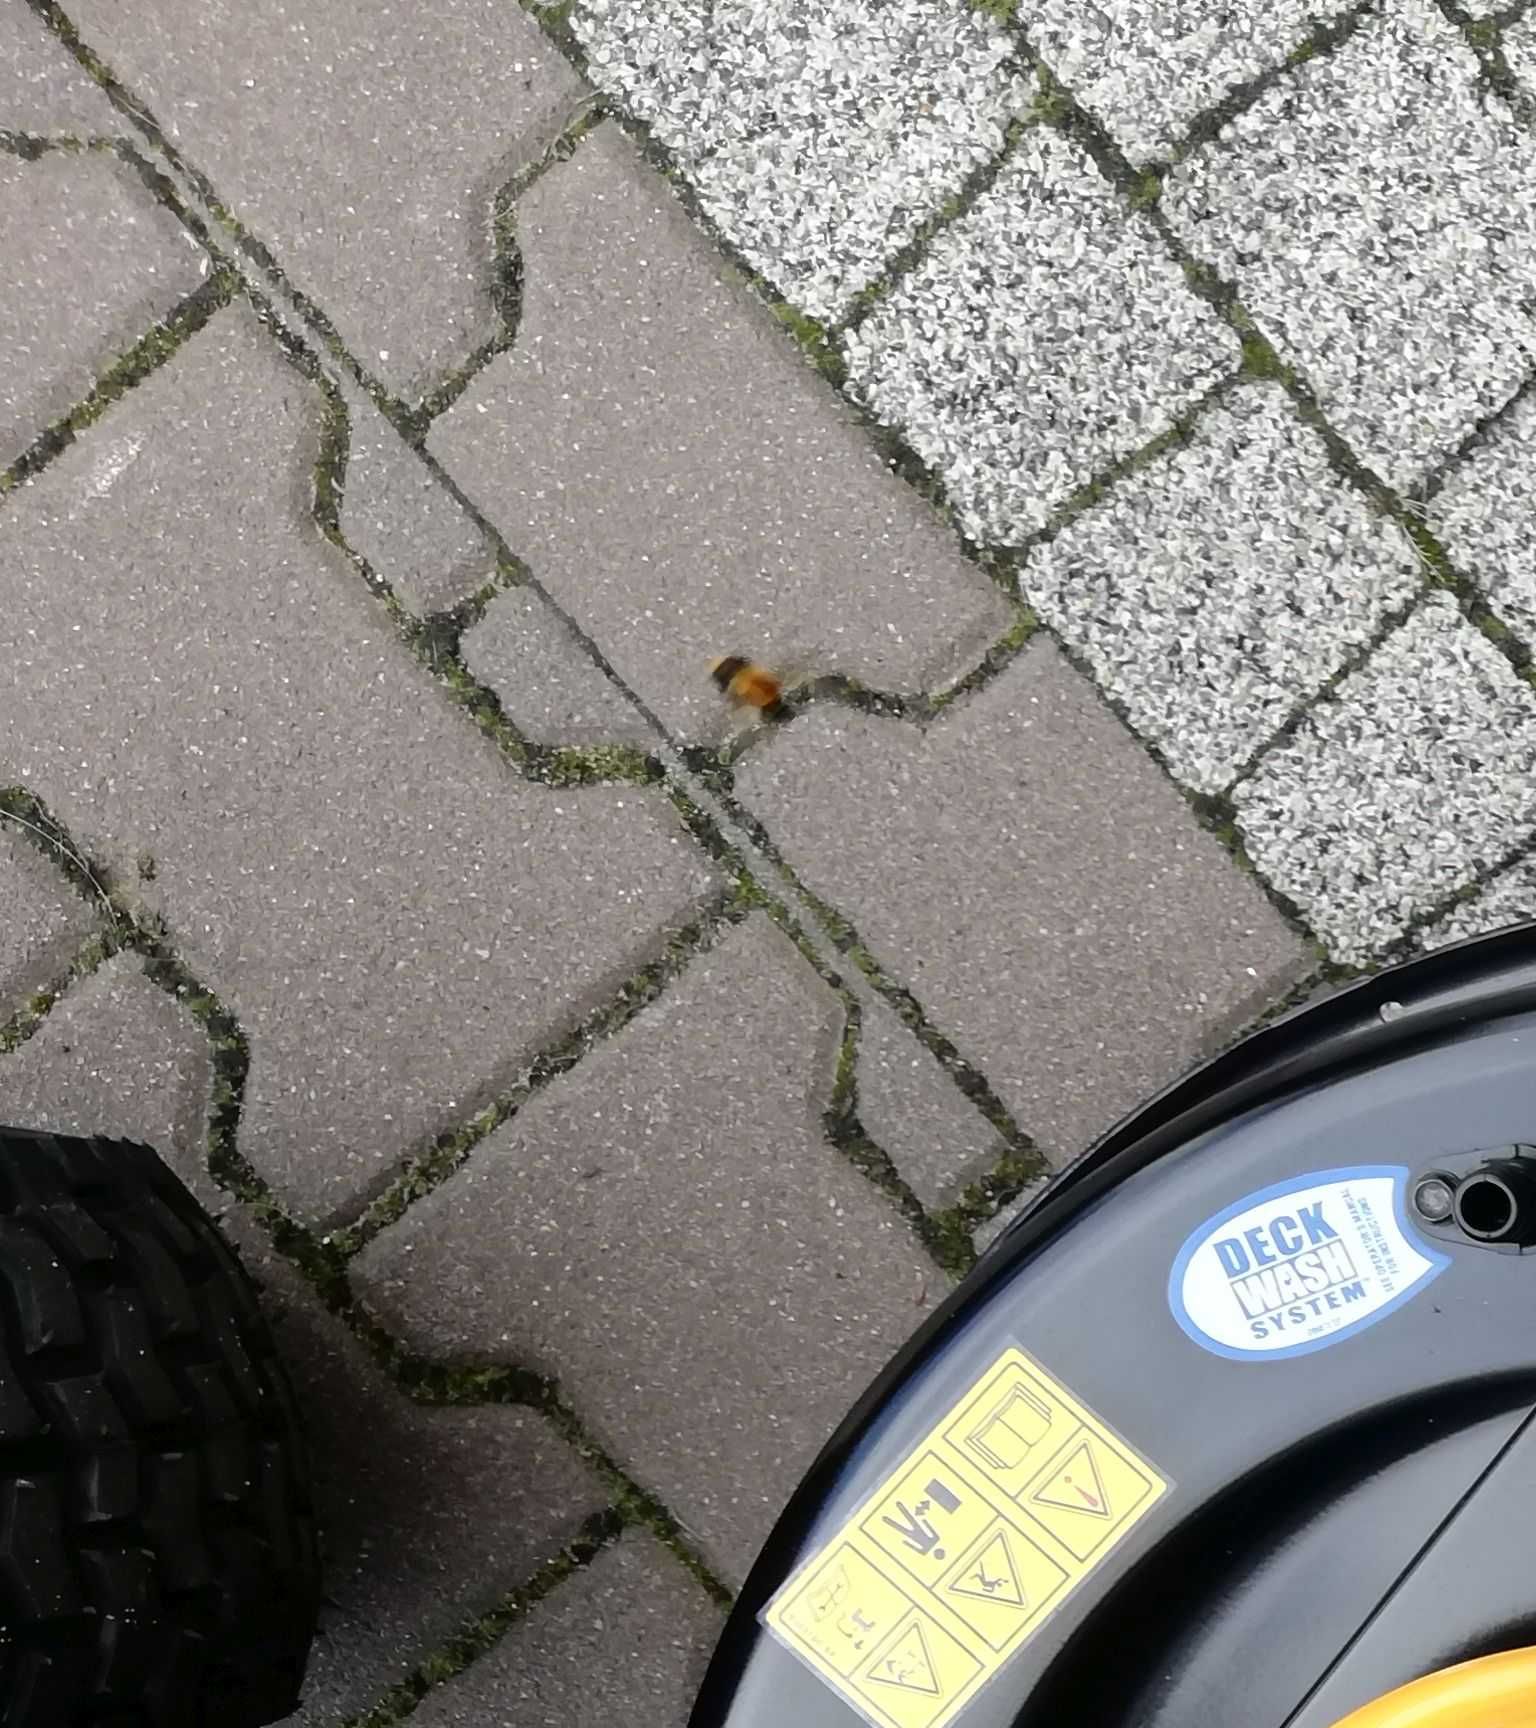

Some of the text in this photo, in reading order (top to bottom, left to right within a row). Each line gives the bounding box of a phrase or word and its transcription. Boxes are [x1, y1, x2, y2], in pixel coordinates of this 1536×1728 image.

[1213, 1201, 1338, 1279] DECK
[1230, 1238, 1357, 1320] WASH
[1251, 1281, 1366, 1339] SYSTEM
